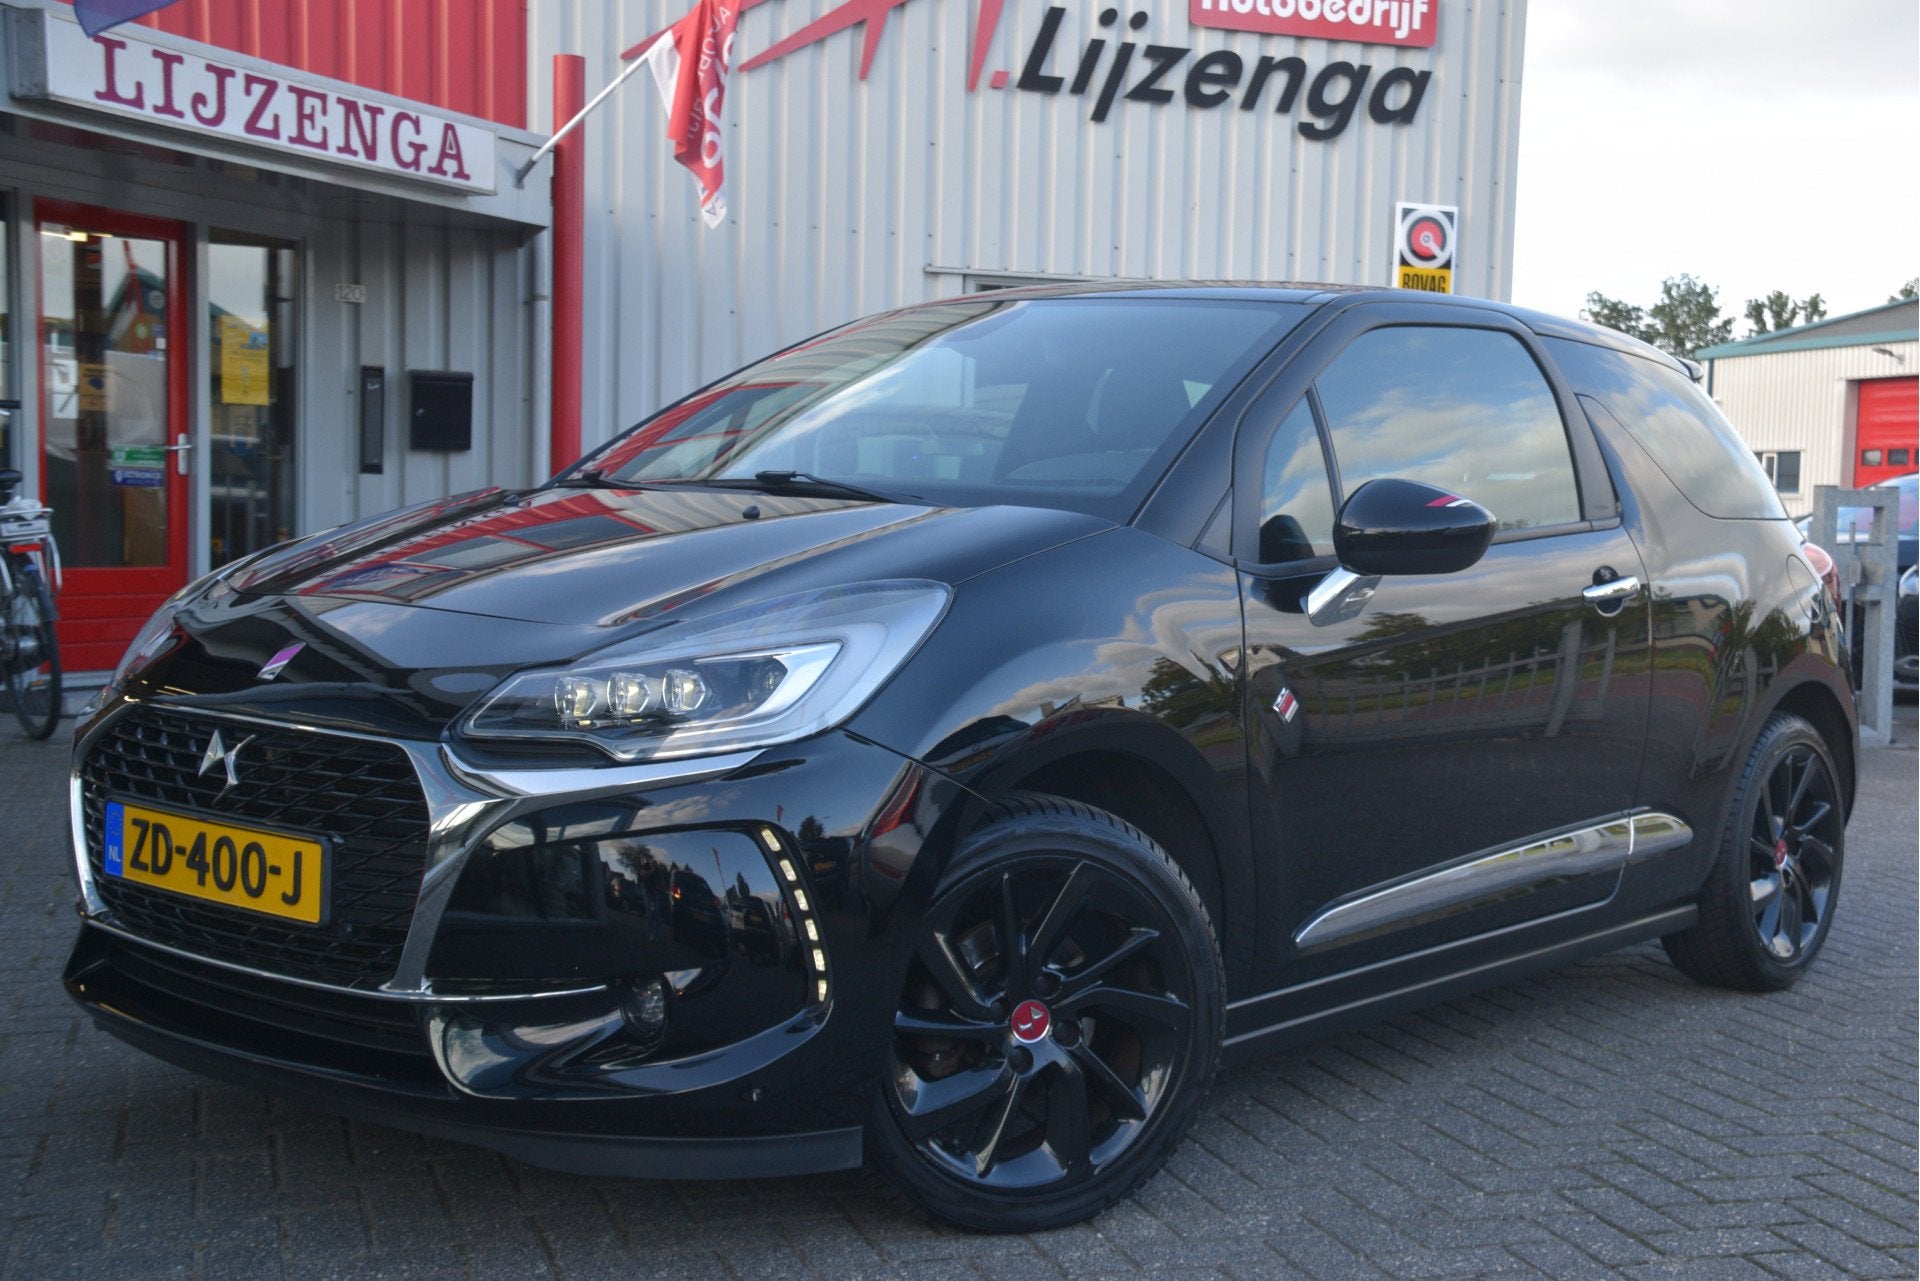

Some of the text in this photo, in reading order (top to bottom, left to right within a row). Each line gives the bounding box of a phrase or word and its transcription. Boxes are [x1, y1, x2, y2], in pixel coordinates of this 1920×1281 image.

[1016, 6, 1432, 141] Lijzenga
[93, 35, 471, 181] LIJZENGA
[338, 285, 361, 301] 120
[1403, 273, 1446, 293] BOVAG
[108, 845, 121, 862] NL
[130, 817, 303, 906] ZD-400-J
